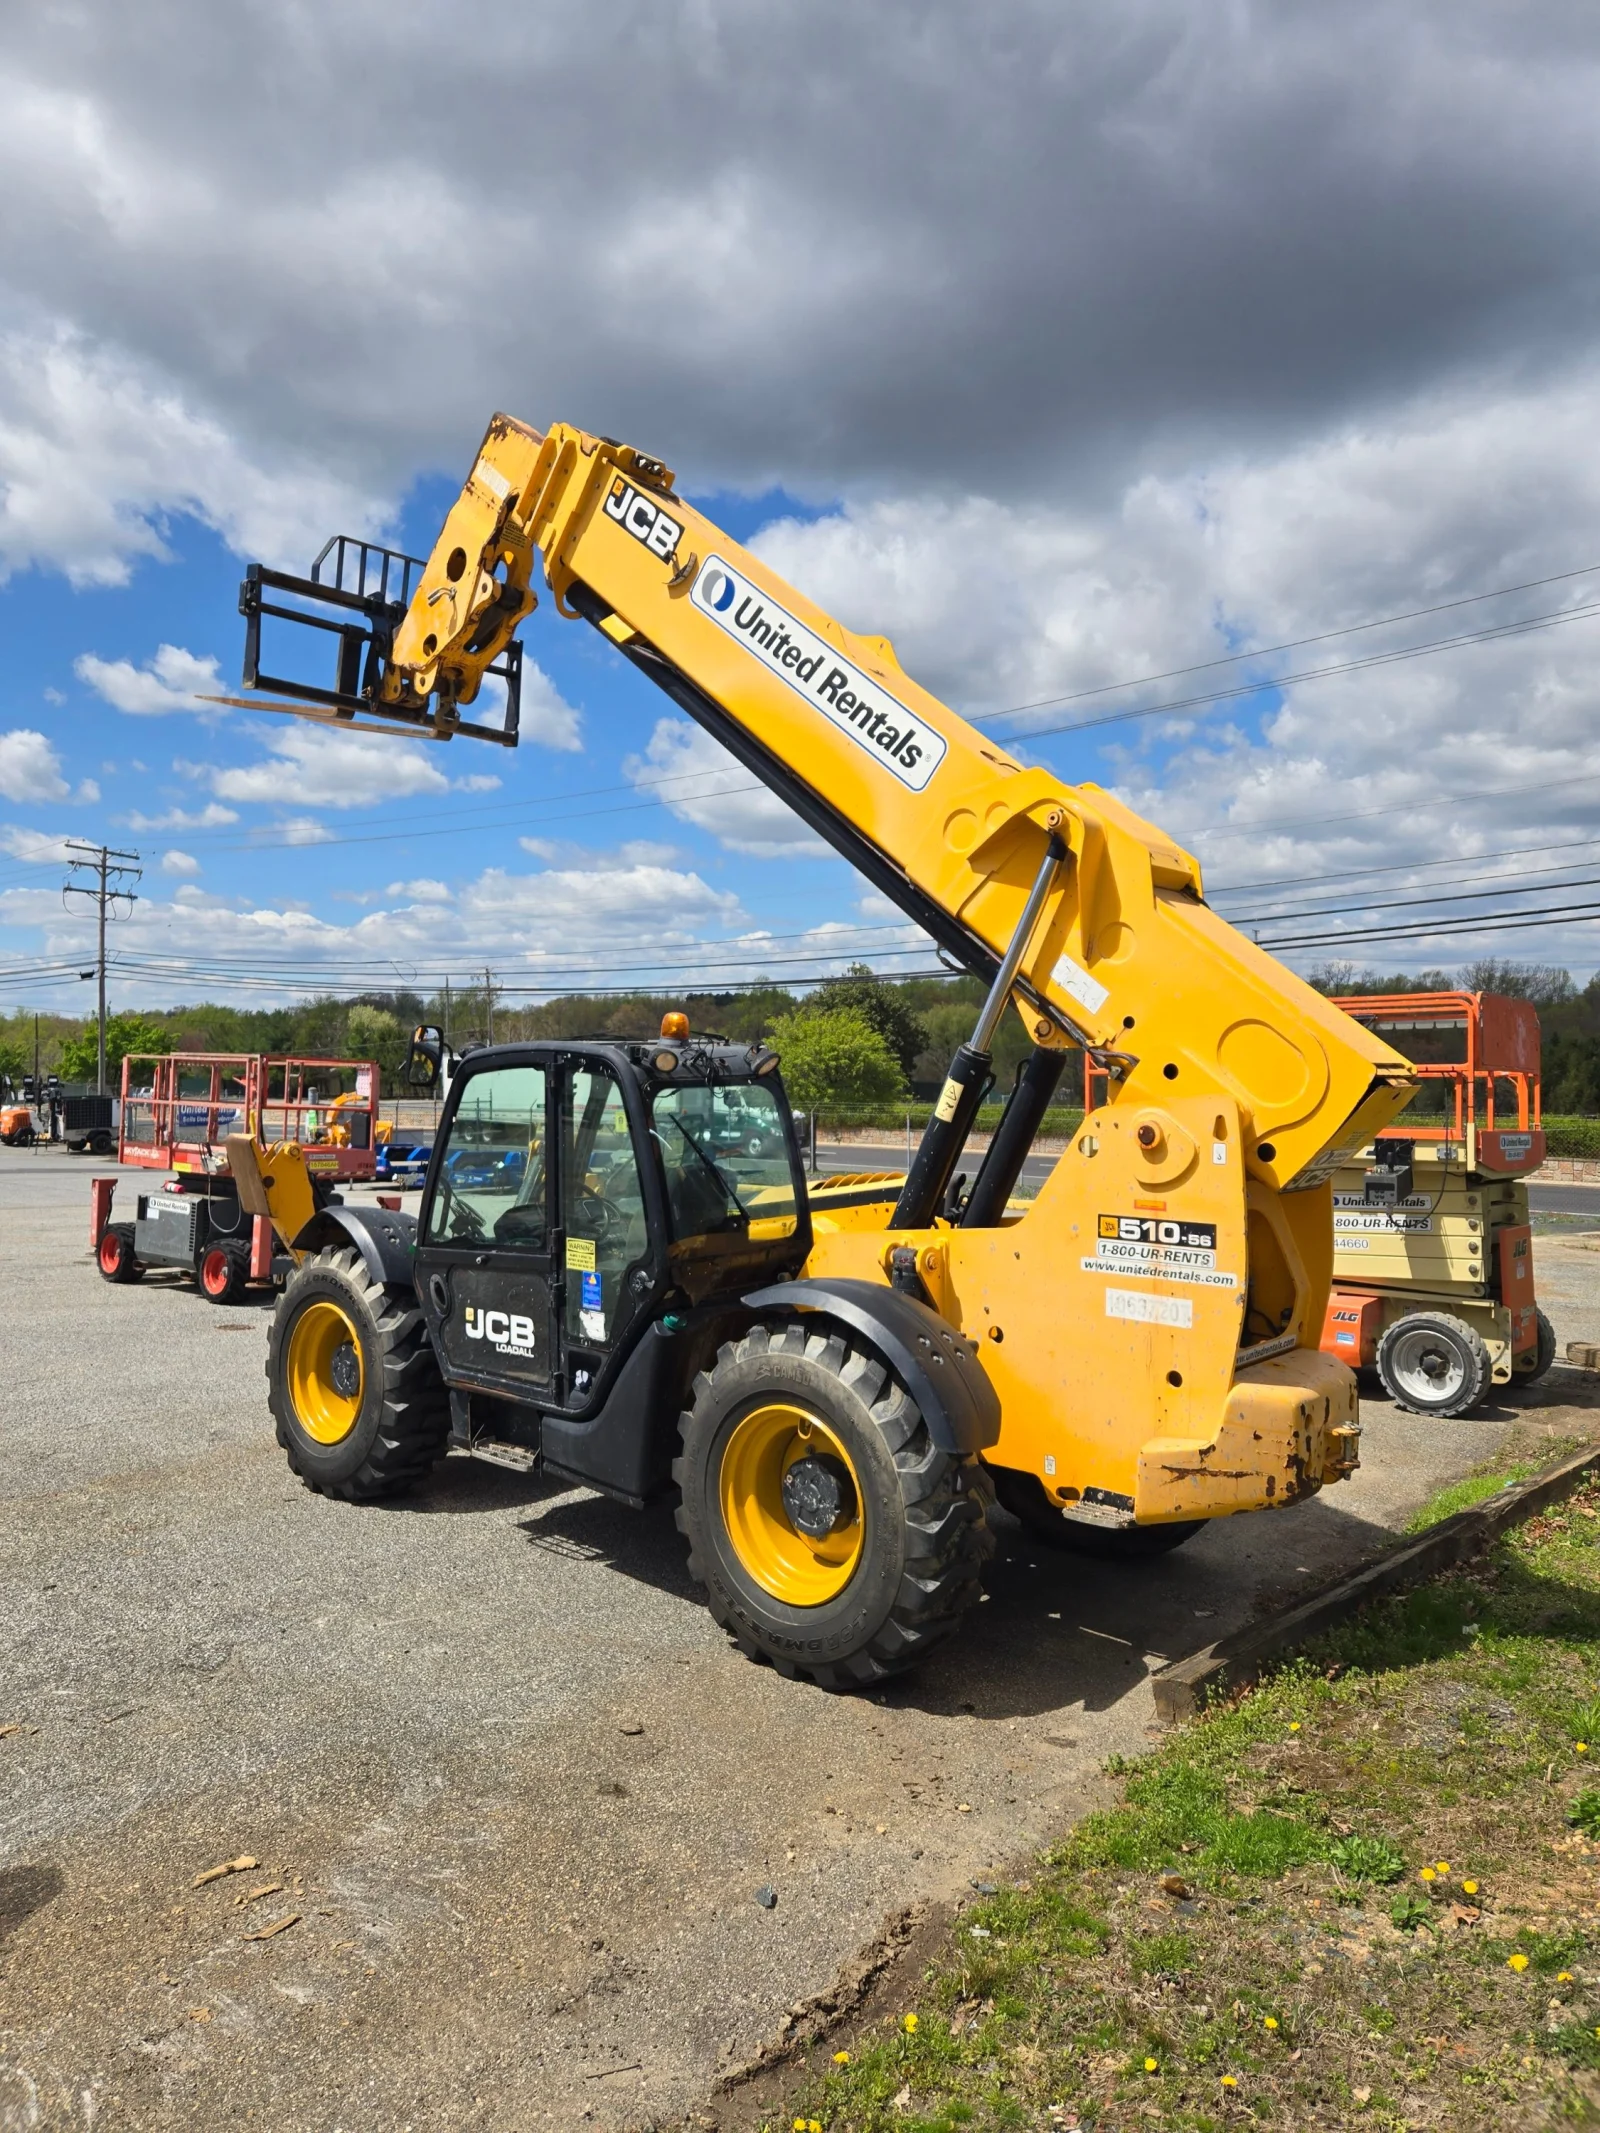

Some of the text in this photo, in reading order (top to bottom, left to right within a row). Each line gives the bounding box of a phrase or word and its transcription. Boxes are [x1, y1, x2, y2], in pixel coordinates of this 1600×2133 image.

[606, 486, 680, 557] JCB
[734, 596, 924, 769] United Rentals
[172, 1203, 188, 1212] Rentals
[1341, 1196, 1381, 1207] United
[1119, 1218, 1212, 1248] 510-56
[568, 1244, 594, 1252] WARNING
[1101, 1244, 1211, 1265] 1-800-UR-RENTS
[1084, 1260, 1234, 1285] www.unitedrentals.com
[1332, 1311, 1359, 1322] JLG
[465, 1308, 536, 1348] JCB
[495, 1343, 535, 1358] LOADALL
[772, 1365, 812, 1386] CAMSO
